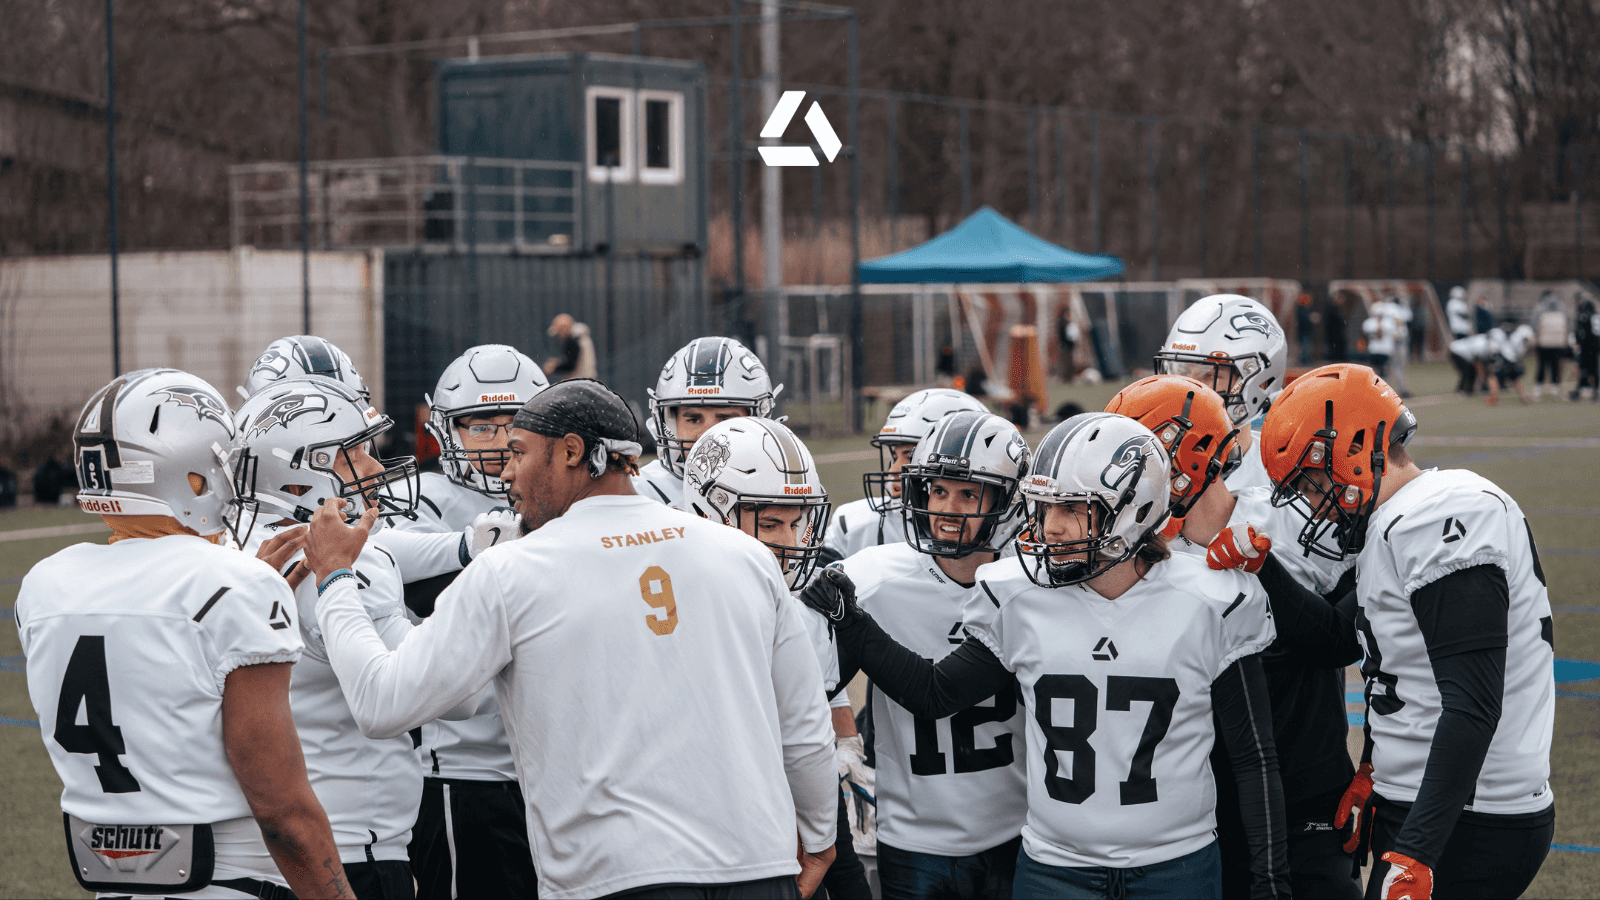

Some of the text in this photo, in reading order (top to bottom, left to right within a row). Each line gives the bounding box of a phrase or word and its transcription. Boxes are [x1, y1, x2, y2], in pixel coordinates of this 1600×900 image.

[1172, 343, 1197, 351] Riddell
[481, 394, 515, 402] Riddell
[688, 387, 720, 395] Riddell
[784, 486, 812, 495] Riddell
[600, 526, 685, 549] STANLEY
[639, 566, 679, 636] 9
[54, 635, 142, 794] 4
[910, 658, 1017, 776] 12
[1034, 674, 1181, 806] 87
[91, 825, 164, 850] schutt
